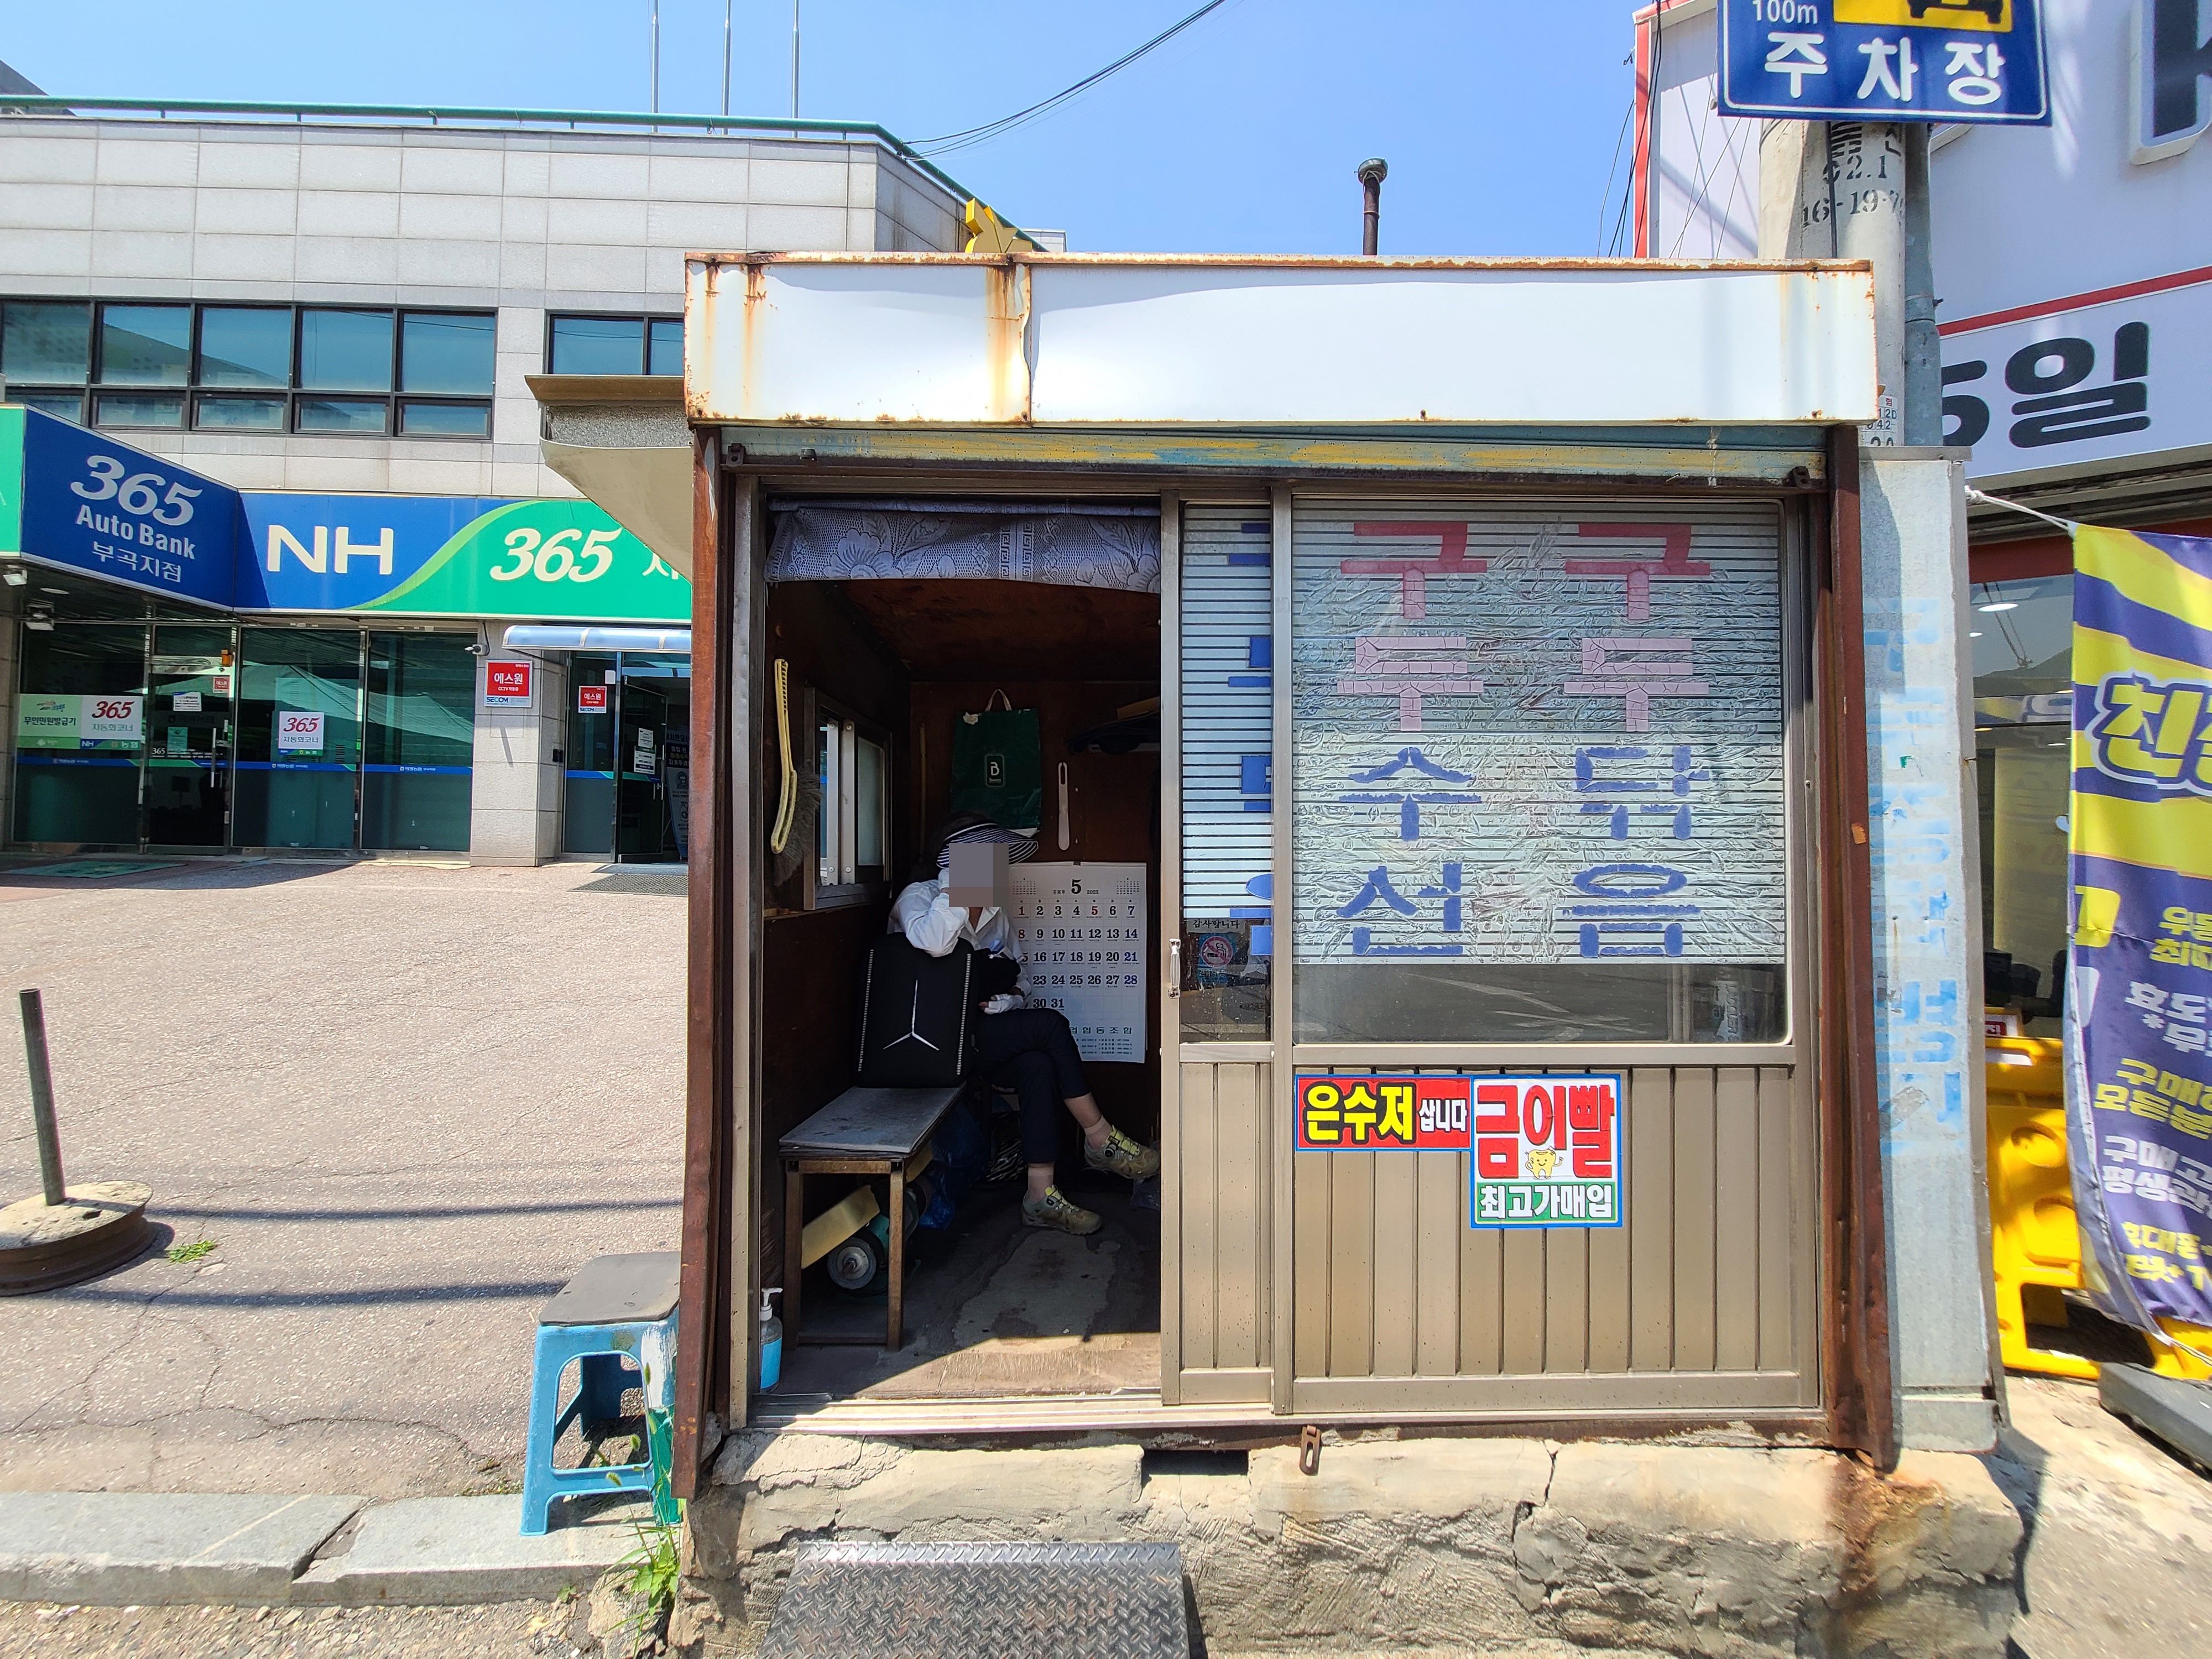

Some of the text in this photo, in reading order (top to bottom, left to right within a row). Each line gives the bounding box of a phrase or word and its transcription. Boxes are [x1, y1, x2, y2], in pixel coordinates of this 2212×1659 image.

[1753, 0, 1818, 24] 100m
[1764, 31, 2006, 105] 주차장
[70, 455, 202, 526] 365
[76, 504, 196, 560] Auto Bank
[92, 541, 182, 583] 부곡지점
[268, 525, 394, 575] NH
[490, 528, 623, 582] 365
[494, 673, 523, 685] 에스원
[92, 701, 134, 719] 365
[24, 717, 76, 726] 무인민원발급기
[92, 723, 133, 732] 자동화코너
[283, 717, 320, 732] 365
[1071, 879, 1082, 894] 5
[1019, 906, 1135, 916] 1 2 3 4 5 6 7
[1192, 920, 1240, 928] 감사합니다
[1019, 929, 1138, 939] 8 9 10 11 12 13 14
[1034, 952, 1047, 962] 16
[1052, 952, 1065, 962] 17
[1070, 952, 1083, 962] 18
[1088, 952, 1102, 962] 19
[1106, 952, 1119, 962] 20
[1124, 952, 1138, 962] 21
[1033, 975, 1138, 985] 23 24 25 26 27 28
[1033, 999, 1065, 1008] 30 31
[2125, 980, 2212, 1023] 효도
[1306, 1085, 1467, 1141] 은수저 삽니다
[1476, 1084, 1614, 1178] 금이빨
[2103, 1165, 2212, 1220] 평생관
[1480, 1185, 1612, 1219] 최고가매입
